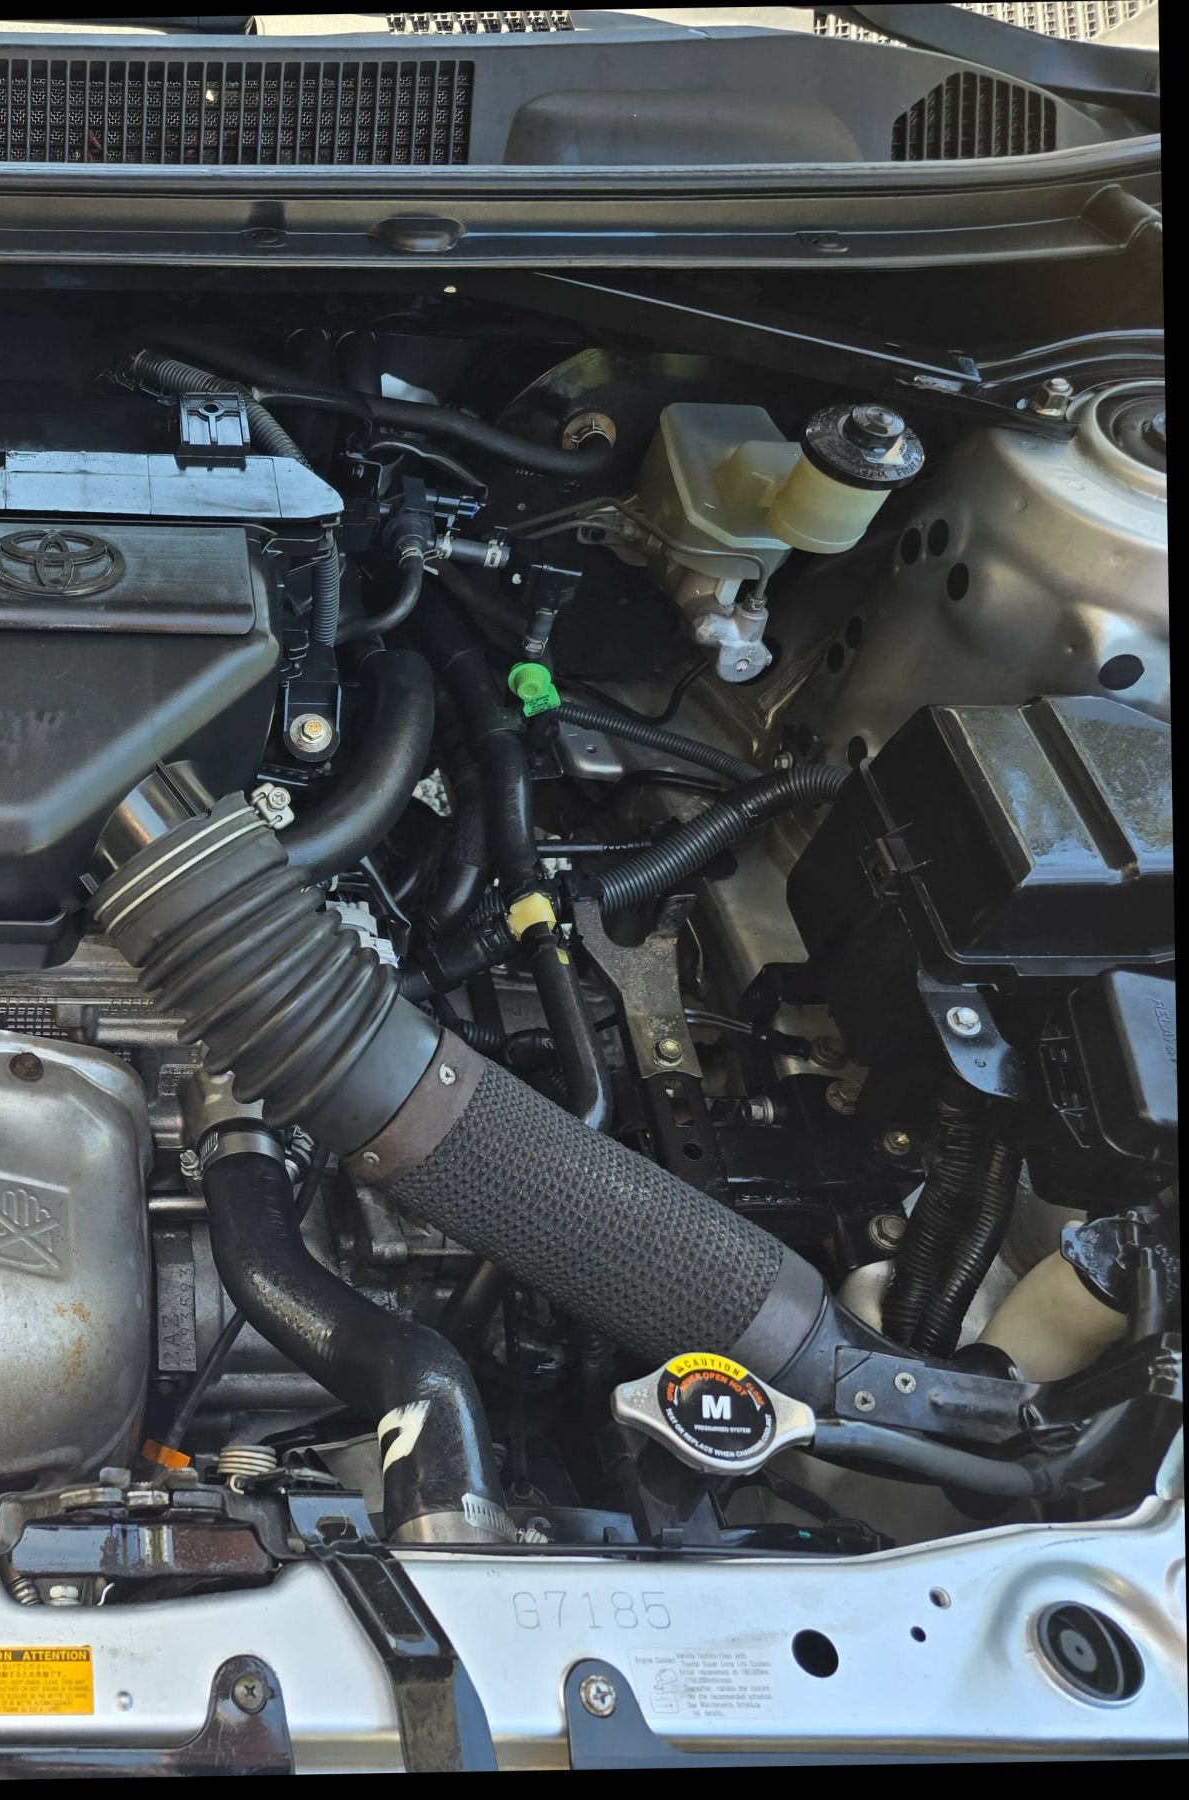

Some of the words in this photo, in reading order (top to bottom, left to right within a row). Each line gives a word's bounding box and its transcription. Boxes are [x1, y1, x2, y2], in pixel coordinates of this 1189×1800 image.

[162, 1314, 181, 1366] 2AZ
[684, 1357, 741, 1377] CAUTION
[702, 1371, 727, 1385] OPEN
[729, 1381, 748, 1397] HOT
[701, 1394, 731, 1420] M
[665, 1407, 676, 1425] TEST
[674, 1422, 684, 1435] OR
[682, 1432, 713, 1453] REPLACE
[713, 1449, 735, 1458] WHEN
[729, 1425, 752, 1434] SYSTEM
[512, 1590, 672, 1630] G7185
[22, 1650, 87, 1661] ATTENTION
[635, 1656, 653, 1665] Engine
[681, 1660, 700, 1668] Toyota
[702, 1660, 718, 1668] Super
[720, 1660, 734, 1668] Long
[736, 1660, 748, 1668] Life
[738, 1684, 748, 1692] the
